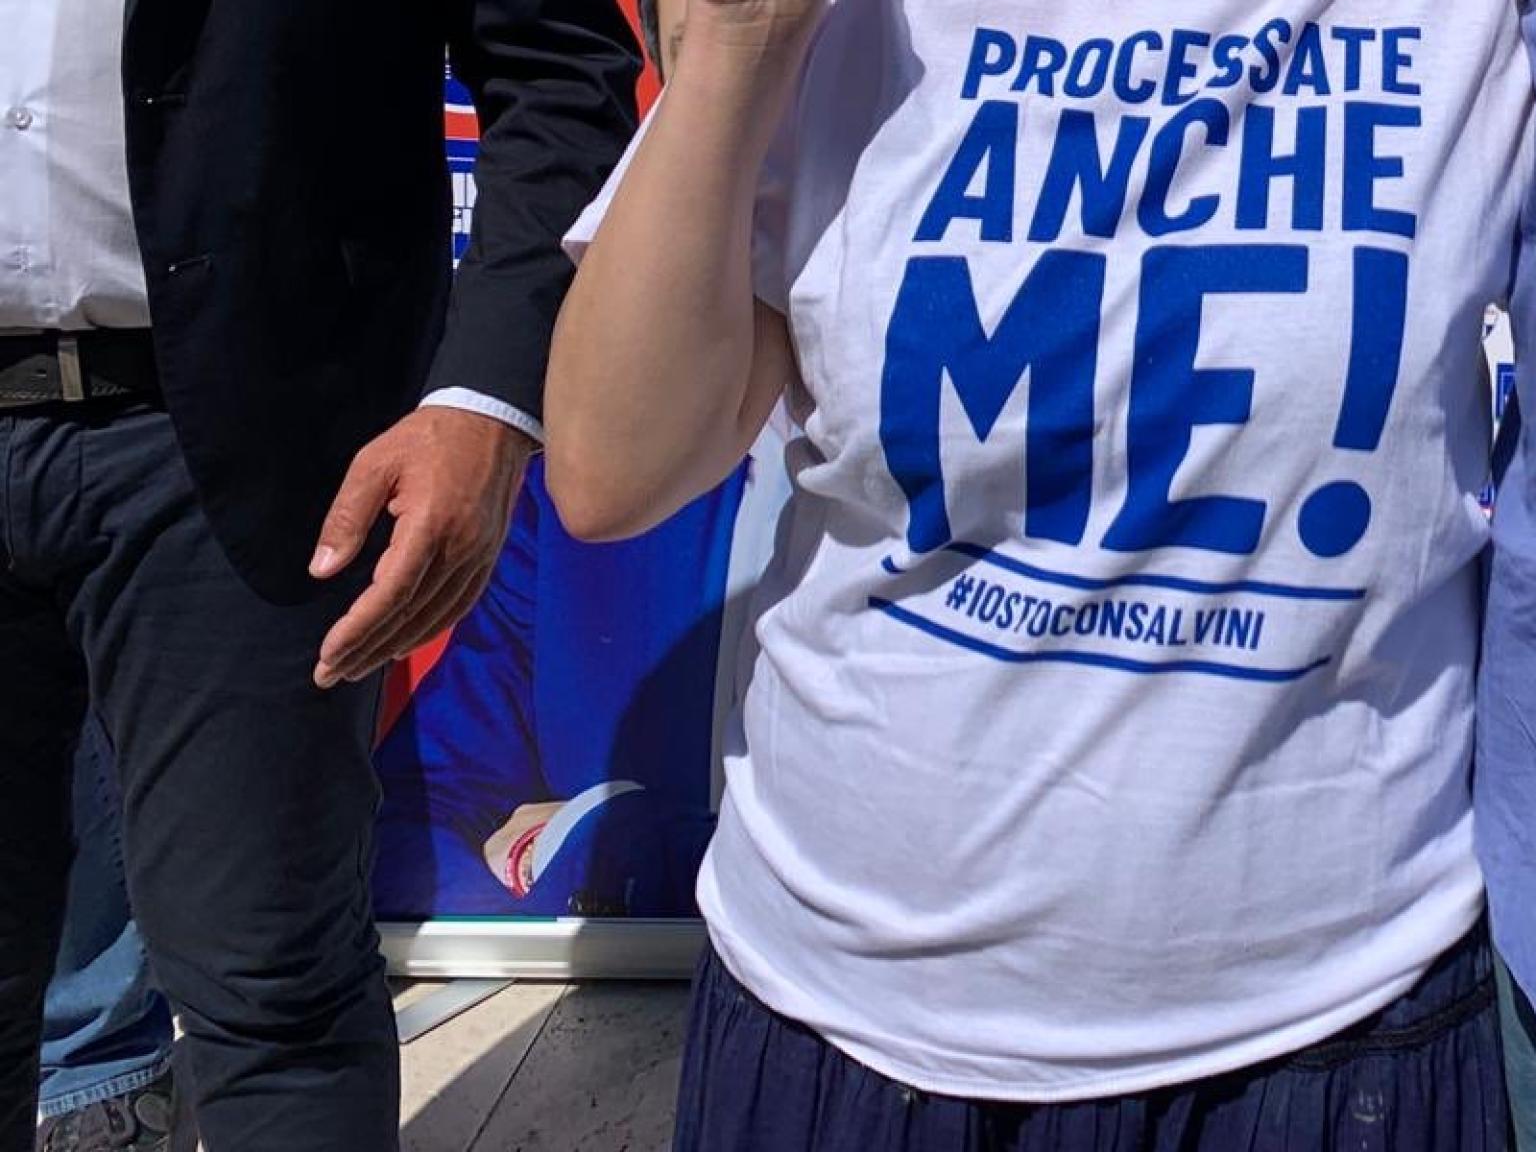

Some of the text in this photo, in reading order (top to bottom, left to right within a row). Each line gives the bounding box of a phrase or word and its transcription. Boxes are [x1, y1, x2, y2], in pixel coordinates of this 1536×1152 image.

[959, 17, 1422, 106] PROCESSATE
[911, 97, 1422, 244] ANCHE
[878, 244, 1409, 559] ME!
[944, 572, 1266, 651] #IOSTOCONSALVINI
